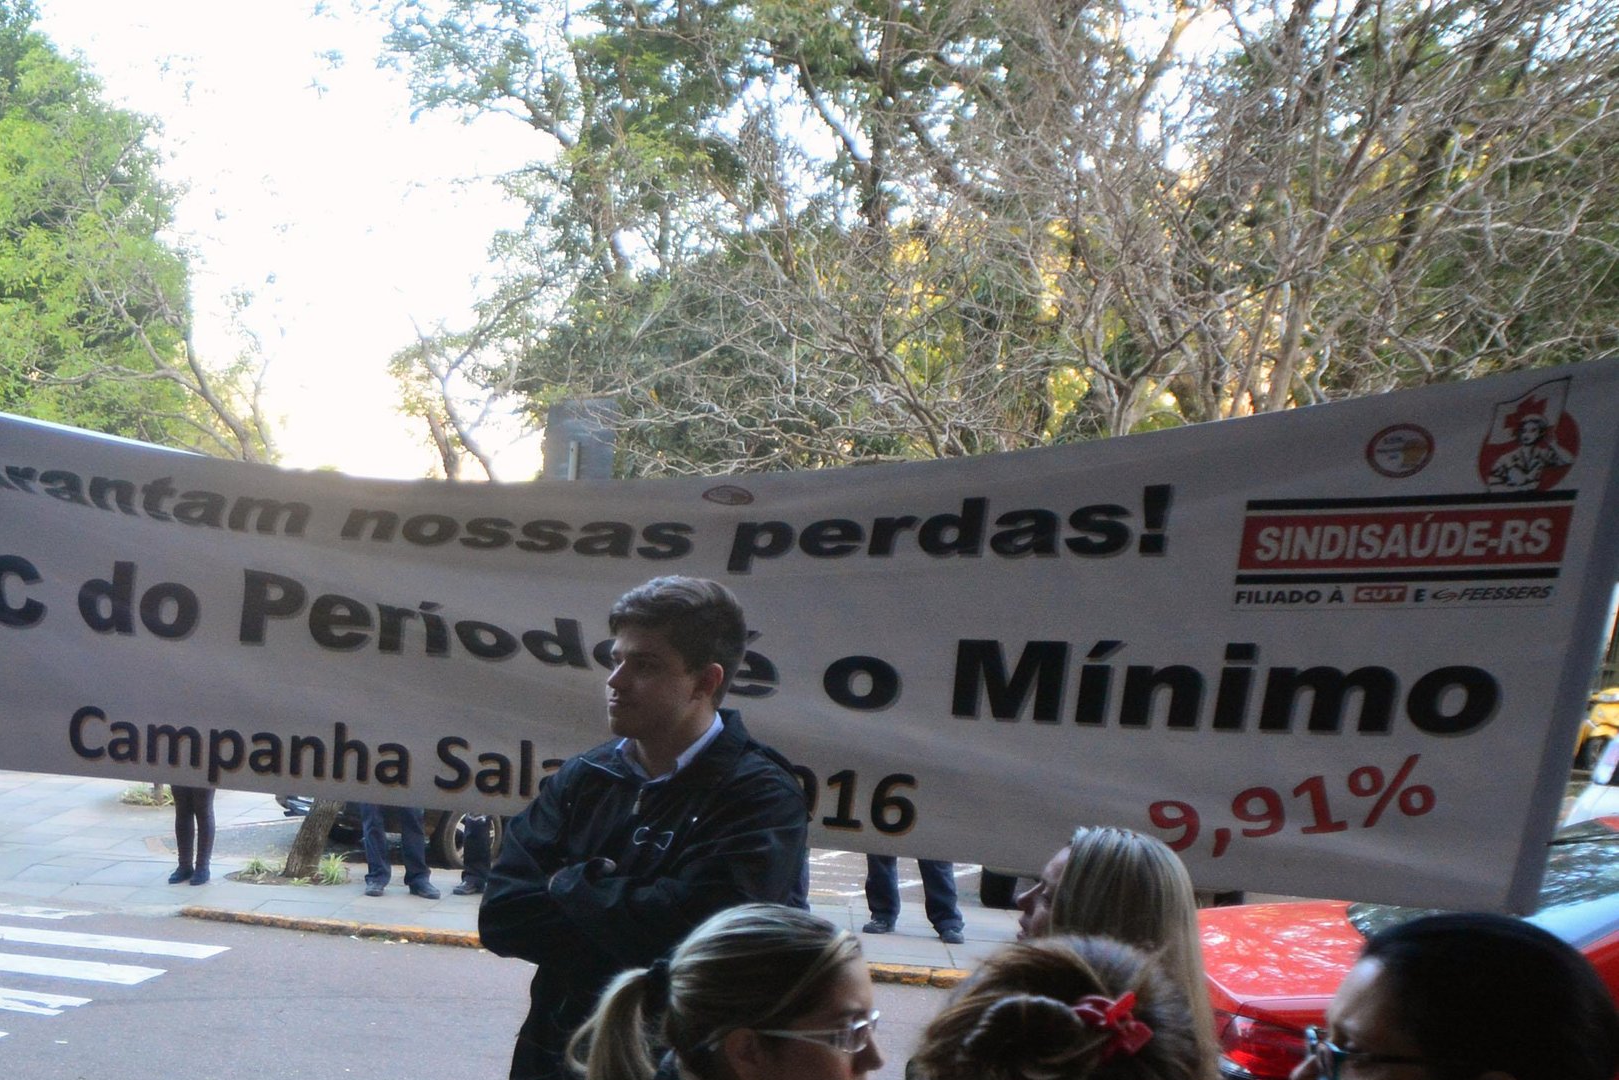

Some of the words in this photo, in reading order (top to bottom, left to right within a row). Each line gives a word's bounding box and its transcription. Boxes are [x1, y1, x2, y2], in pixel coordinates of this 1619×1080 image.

[340, 507, 694, 560] nossas
[727, 484, 1174, 573] perdas!
[1255, 513, 1553, 562] SINDISAÚDE-RS
[1235, 589, 1322, 605] FILIADO
[1327, 586, 1344, 604] À
[1356, 587, 1406, 601] CUT
[1414, 588, 1426, 602] E
[1460, 586, 1553, 600] FEESSERS
[78, 561, 201, 640] do
[822, 654, 902, 712] o
[951, 638, 1502, 737] Mínimo
[69, 705, 411, 788] Campanha
[1148, 753, 1437, 858] 9,91%
